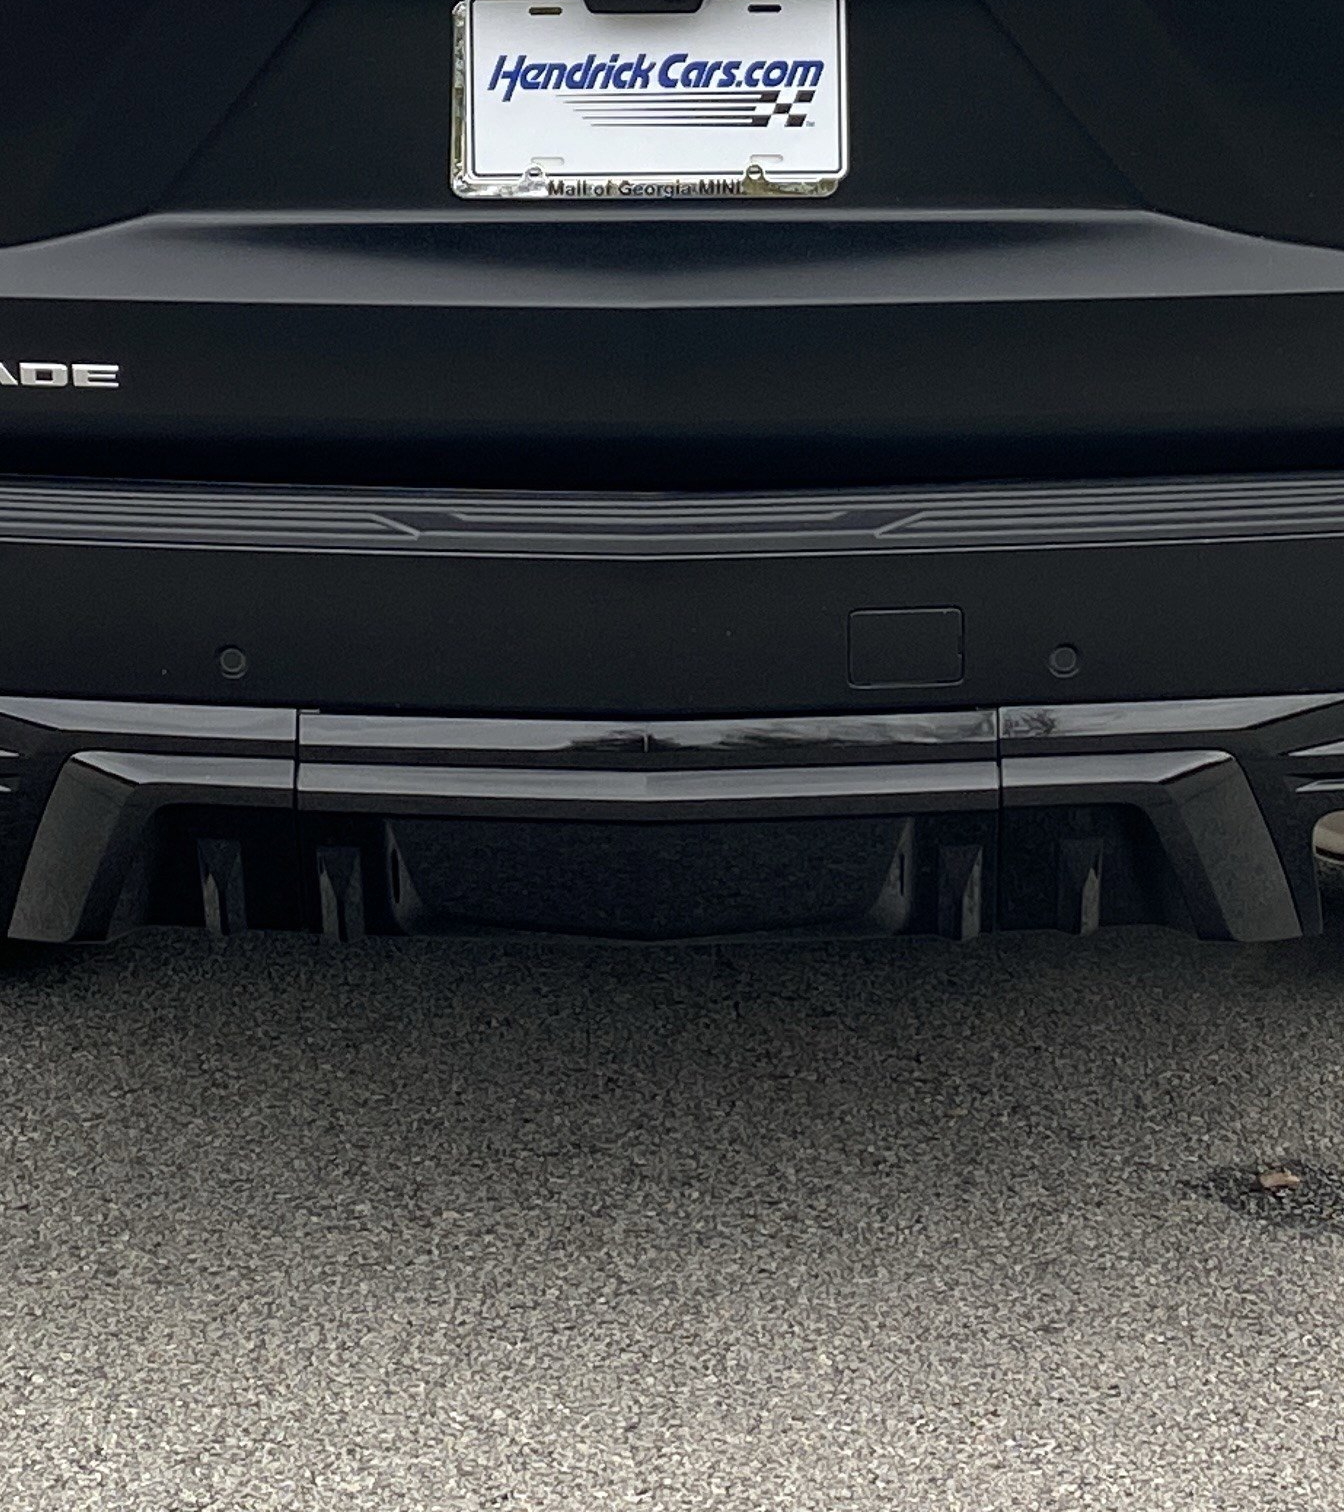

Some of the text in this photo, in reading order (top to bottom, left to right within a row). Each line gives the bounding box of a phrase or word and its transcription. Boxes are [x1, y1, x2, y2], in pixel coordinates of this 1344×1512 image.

[548, 179, 587, 196] Mall
[594, 179, 610, 197] of
[619, 179, 693, 199] Georgia
